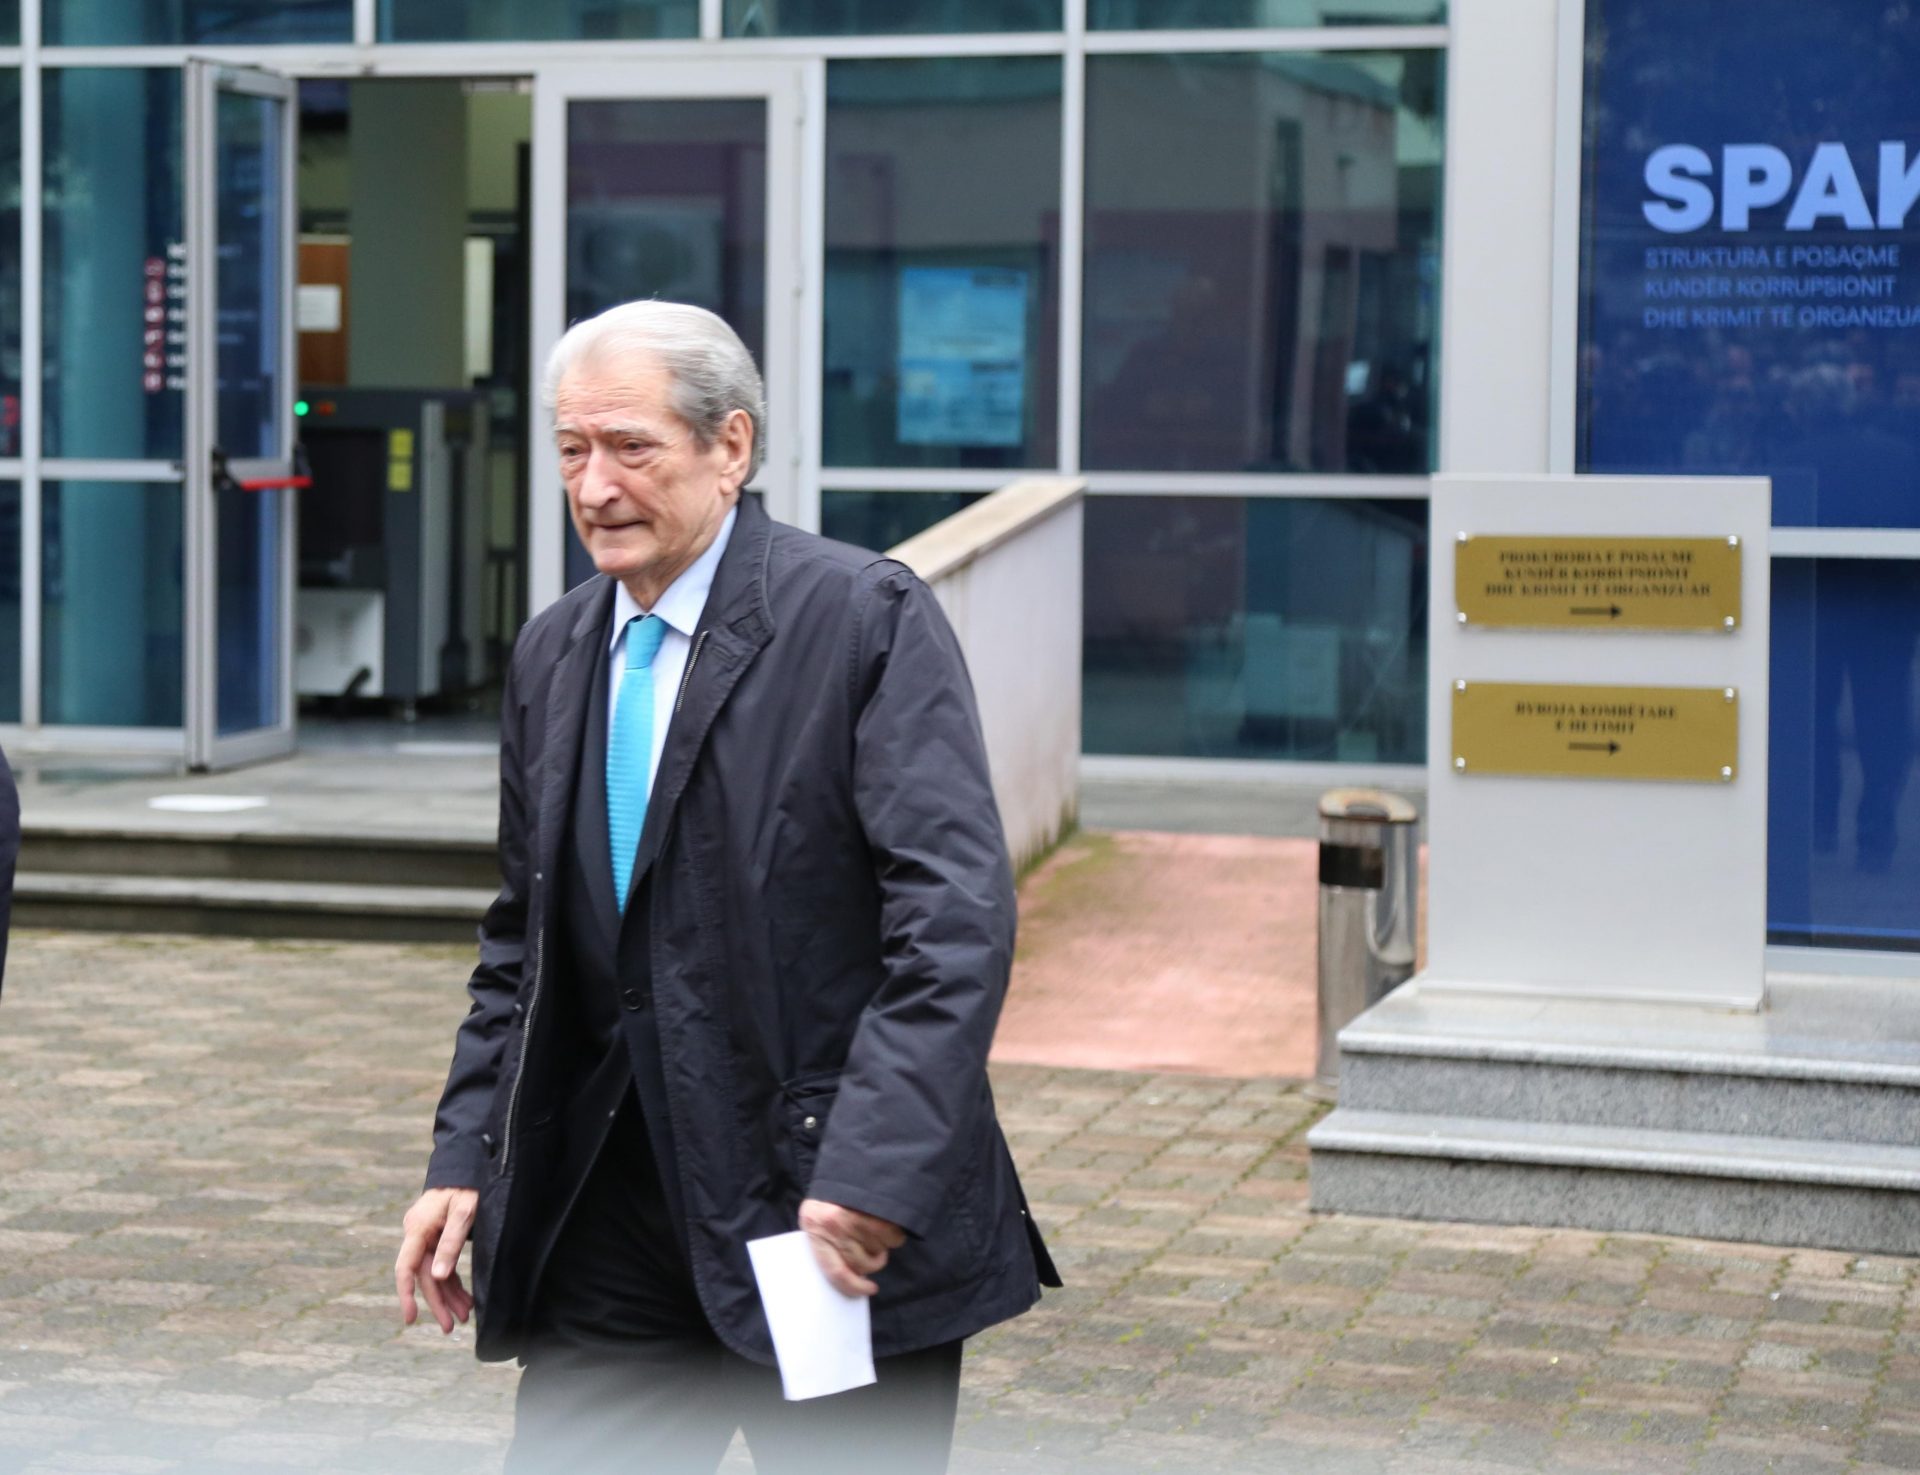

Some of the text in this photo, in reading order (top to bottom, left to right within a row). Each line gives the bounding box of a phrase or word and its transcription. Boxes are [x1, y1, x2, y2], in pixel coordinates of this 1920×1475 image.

[1642, 140, 1920, 233] SPAK
[1645, 244, 1900, 270] STRUKTURA E POSAÇME
[1737, 274, 1896, 298] KORRUPSIONIT
[1644, 306, 1687, 328] DHE
[1691, 306, 1763, 328] KRIMIT
